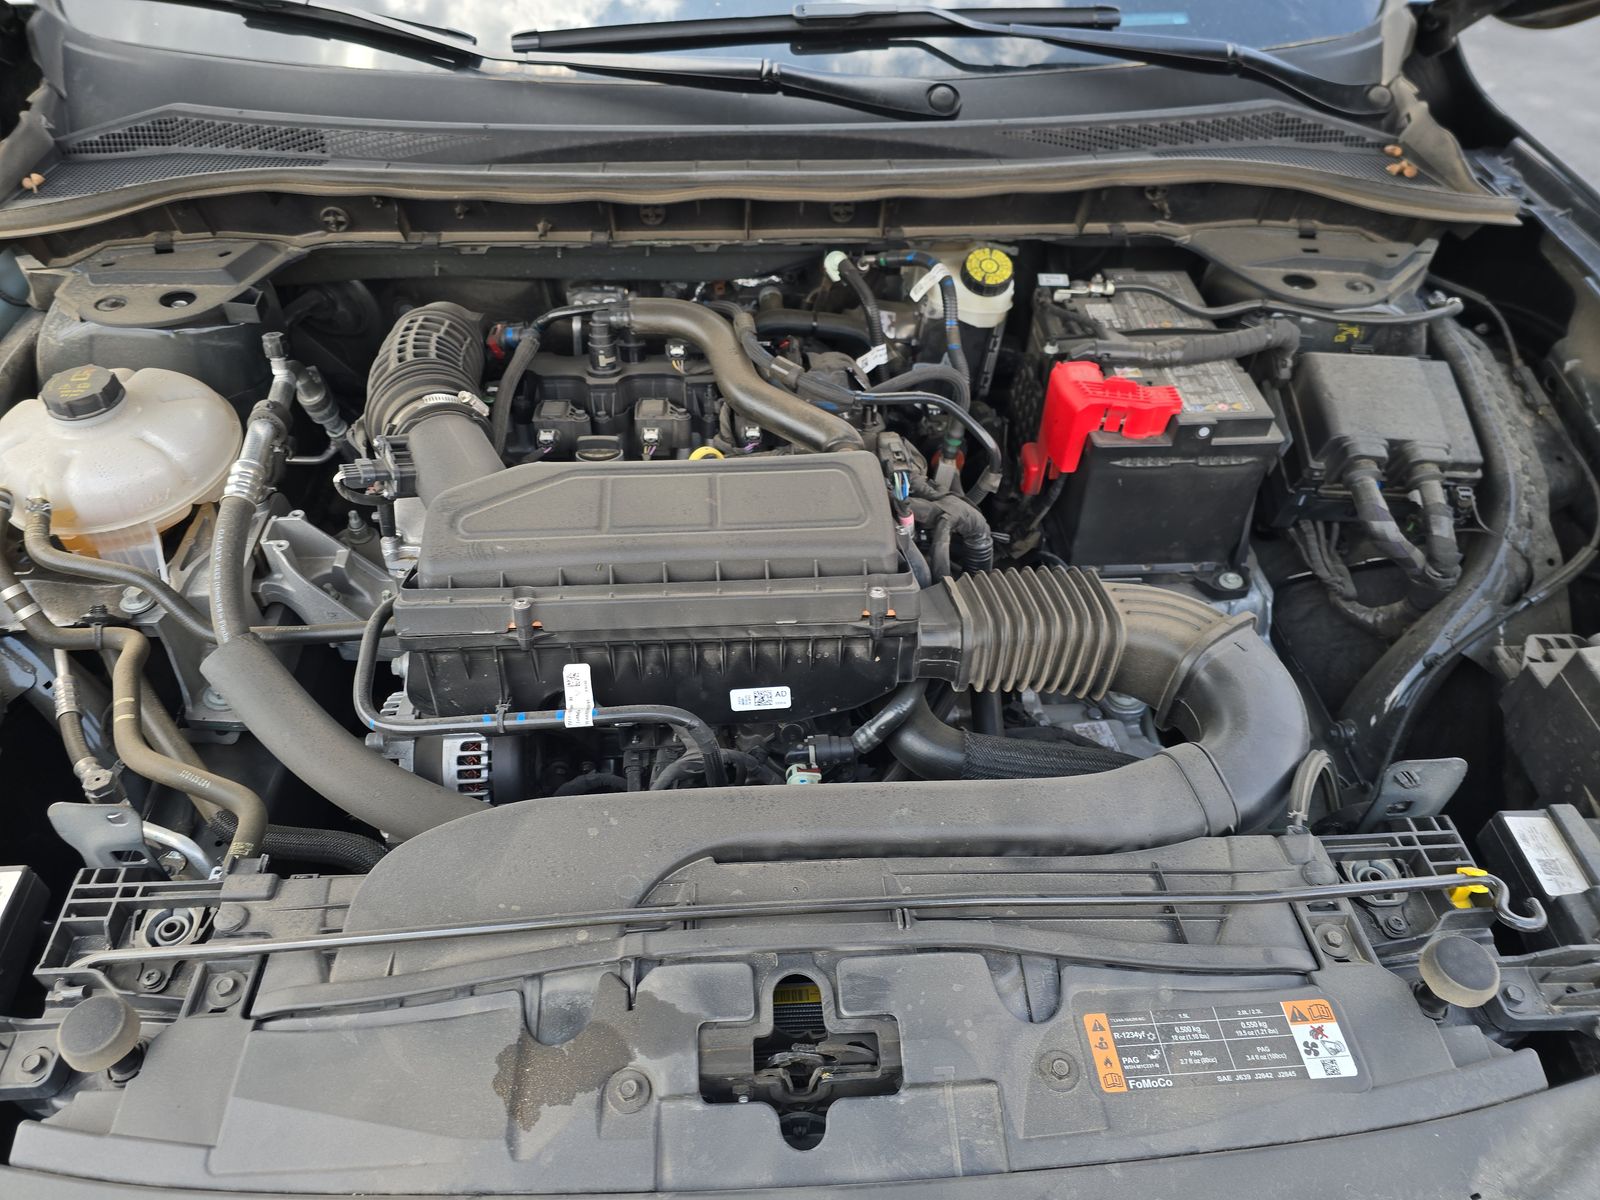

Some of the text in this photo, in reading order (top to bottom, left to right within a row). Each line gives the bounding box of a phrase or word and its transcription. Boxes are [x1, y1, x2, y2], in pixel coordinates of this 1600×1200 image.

[775, 690, 787, 698] AD
[1191, 1025, 1202, 1033] kg
[1240, 1020, 1268, 1029] 0.550 kg
[1113, 1031, 1146, 1040] R-1234yf
[1122, 1056, 1140, 1064] PAG
[1235, 1073, 1252, 1081] J639
[1254, 1072, 1274, 1080] J2842
[1277, 1070, 1297, 1078] J2845
[1129, 1077, 1173, 1089] FoMoCo
